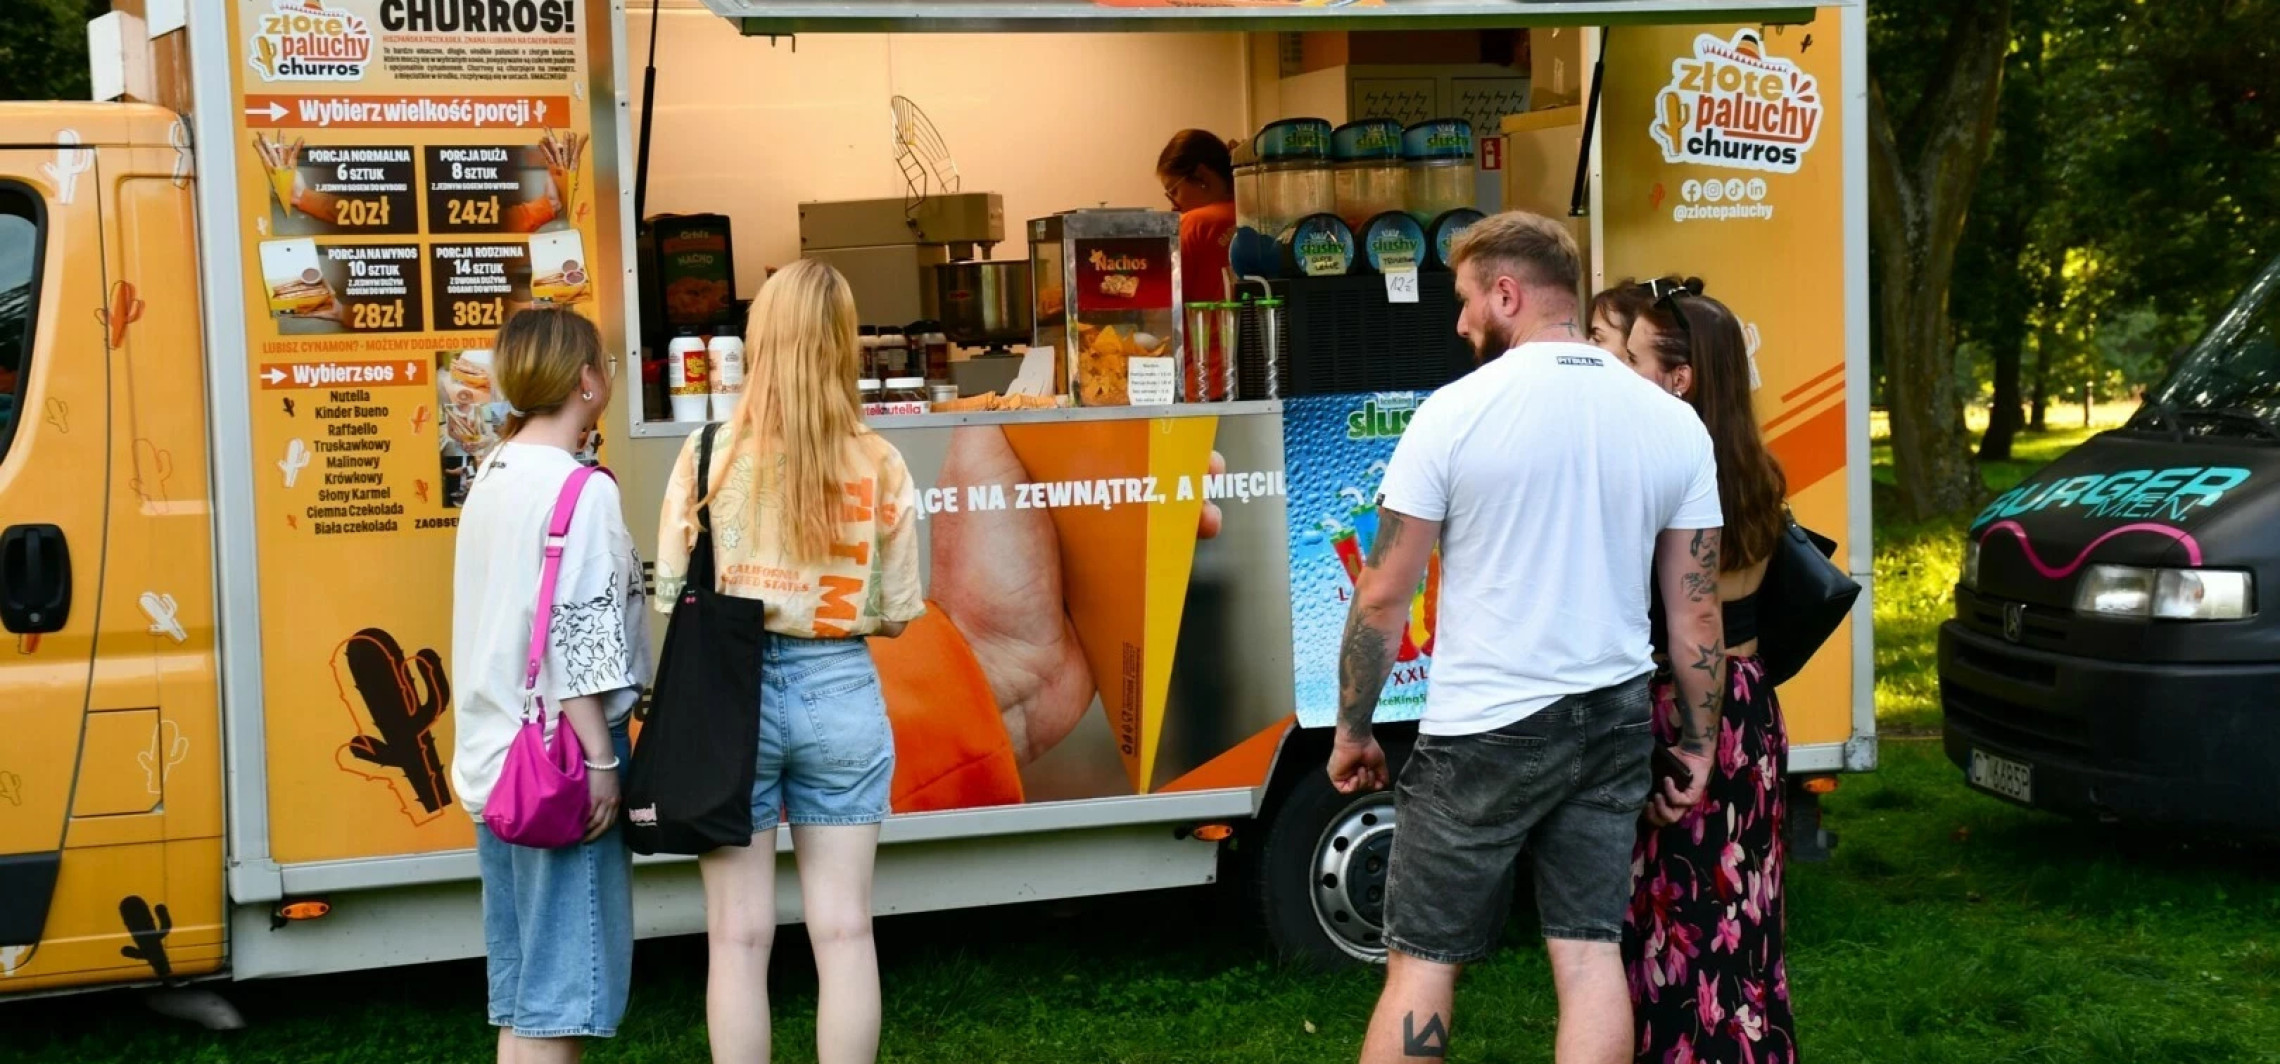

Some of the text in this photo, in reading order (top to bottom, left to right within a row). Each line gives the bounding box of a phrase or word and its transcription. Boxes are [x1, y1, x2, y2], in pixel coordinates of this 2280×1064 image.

[380, 0, 575, 33] CHURROS!
[282, 32, 370, 62] paluchy
[278, 57, 360, 76] churros
[1678, 61, 1784, 101] złote
[298, 98, 529, 127] Wybierz wielkość porcji
[1696, 92, 1817, 144] paluchy
[1687, 128, 1797, 164] churros
[309, 150, 411, 162] PORCJA NORMALNA
[440, 148, 508, 162] PORCJA DUŻA
[337, 163, 385, 181] 6 SZTUK
[452, 162, 498, 180] 8 SZTUK
[335, 195, 390, 225] 20zł
[447, 195, 500, 225] 24zł
[436, 246, 523, 258] PORCJA RODZINNA
[1301, 241, 1345, 254] slushy
[1372, 238, 1418, 252] slushy
[328, 248, 366, 260] PORCJA
[381, 248, 418, 259] WYNOS
[1093, 254, 1148, 271] Nachos
[348, 261, 400, 276] 10 SZTUK
[453, 259, 504, 275] 14 SZTUK
[352, 299, 404, 328] 28zł
[453, 297, 504, 326] 38zł
[263, 341, 298, 353] LUBISZ
[301, 340, 359, 353] CYNAMON?
[366, 338, 410, 351] MOŻEMY
[462, 338, 476, 348] DO
[292, 363, 394, 388] Wybierz sos
[330, 389, 370, 403] Nutella
[315, 405, 389, 419] Kinder Bueno
[328, 422, 378, 436] Raffaello
[314, 439, 391, 453] Truskawkowy
[326, 455, 380, 469] Malinowy
[325, 472, 384, 486] Krówkowy
[318, 487, 391, 502] Słony Karmel
[967, 484, 1006, 512] NA
[1014, 476, 1166, 511] ZEWNĄTRZ,
[1176, 475, 1195, 502] A
[1970, 466, 2252, 531] BURGER
[307, 502, 404, 518] Ciemna Czekolada
[314, 518, 398, 535] Biała czekolada
[727, 563, 799, 581] CALIFORNIA
[763, 579, 809, 592] STATES
[1393, 666, 1428, 686] XXL
